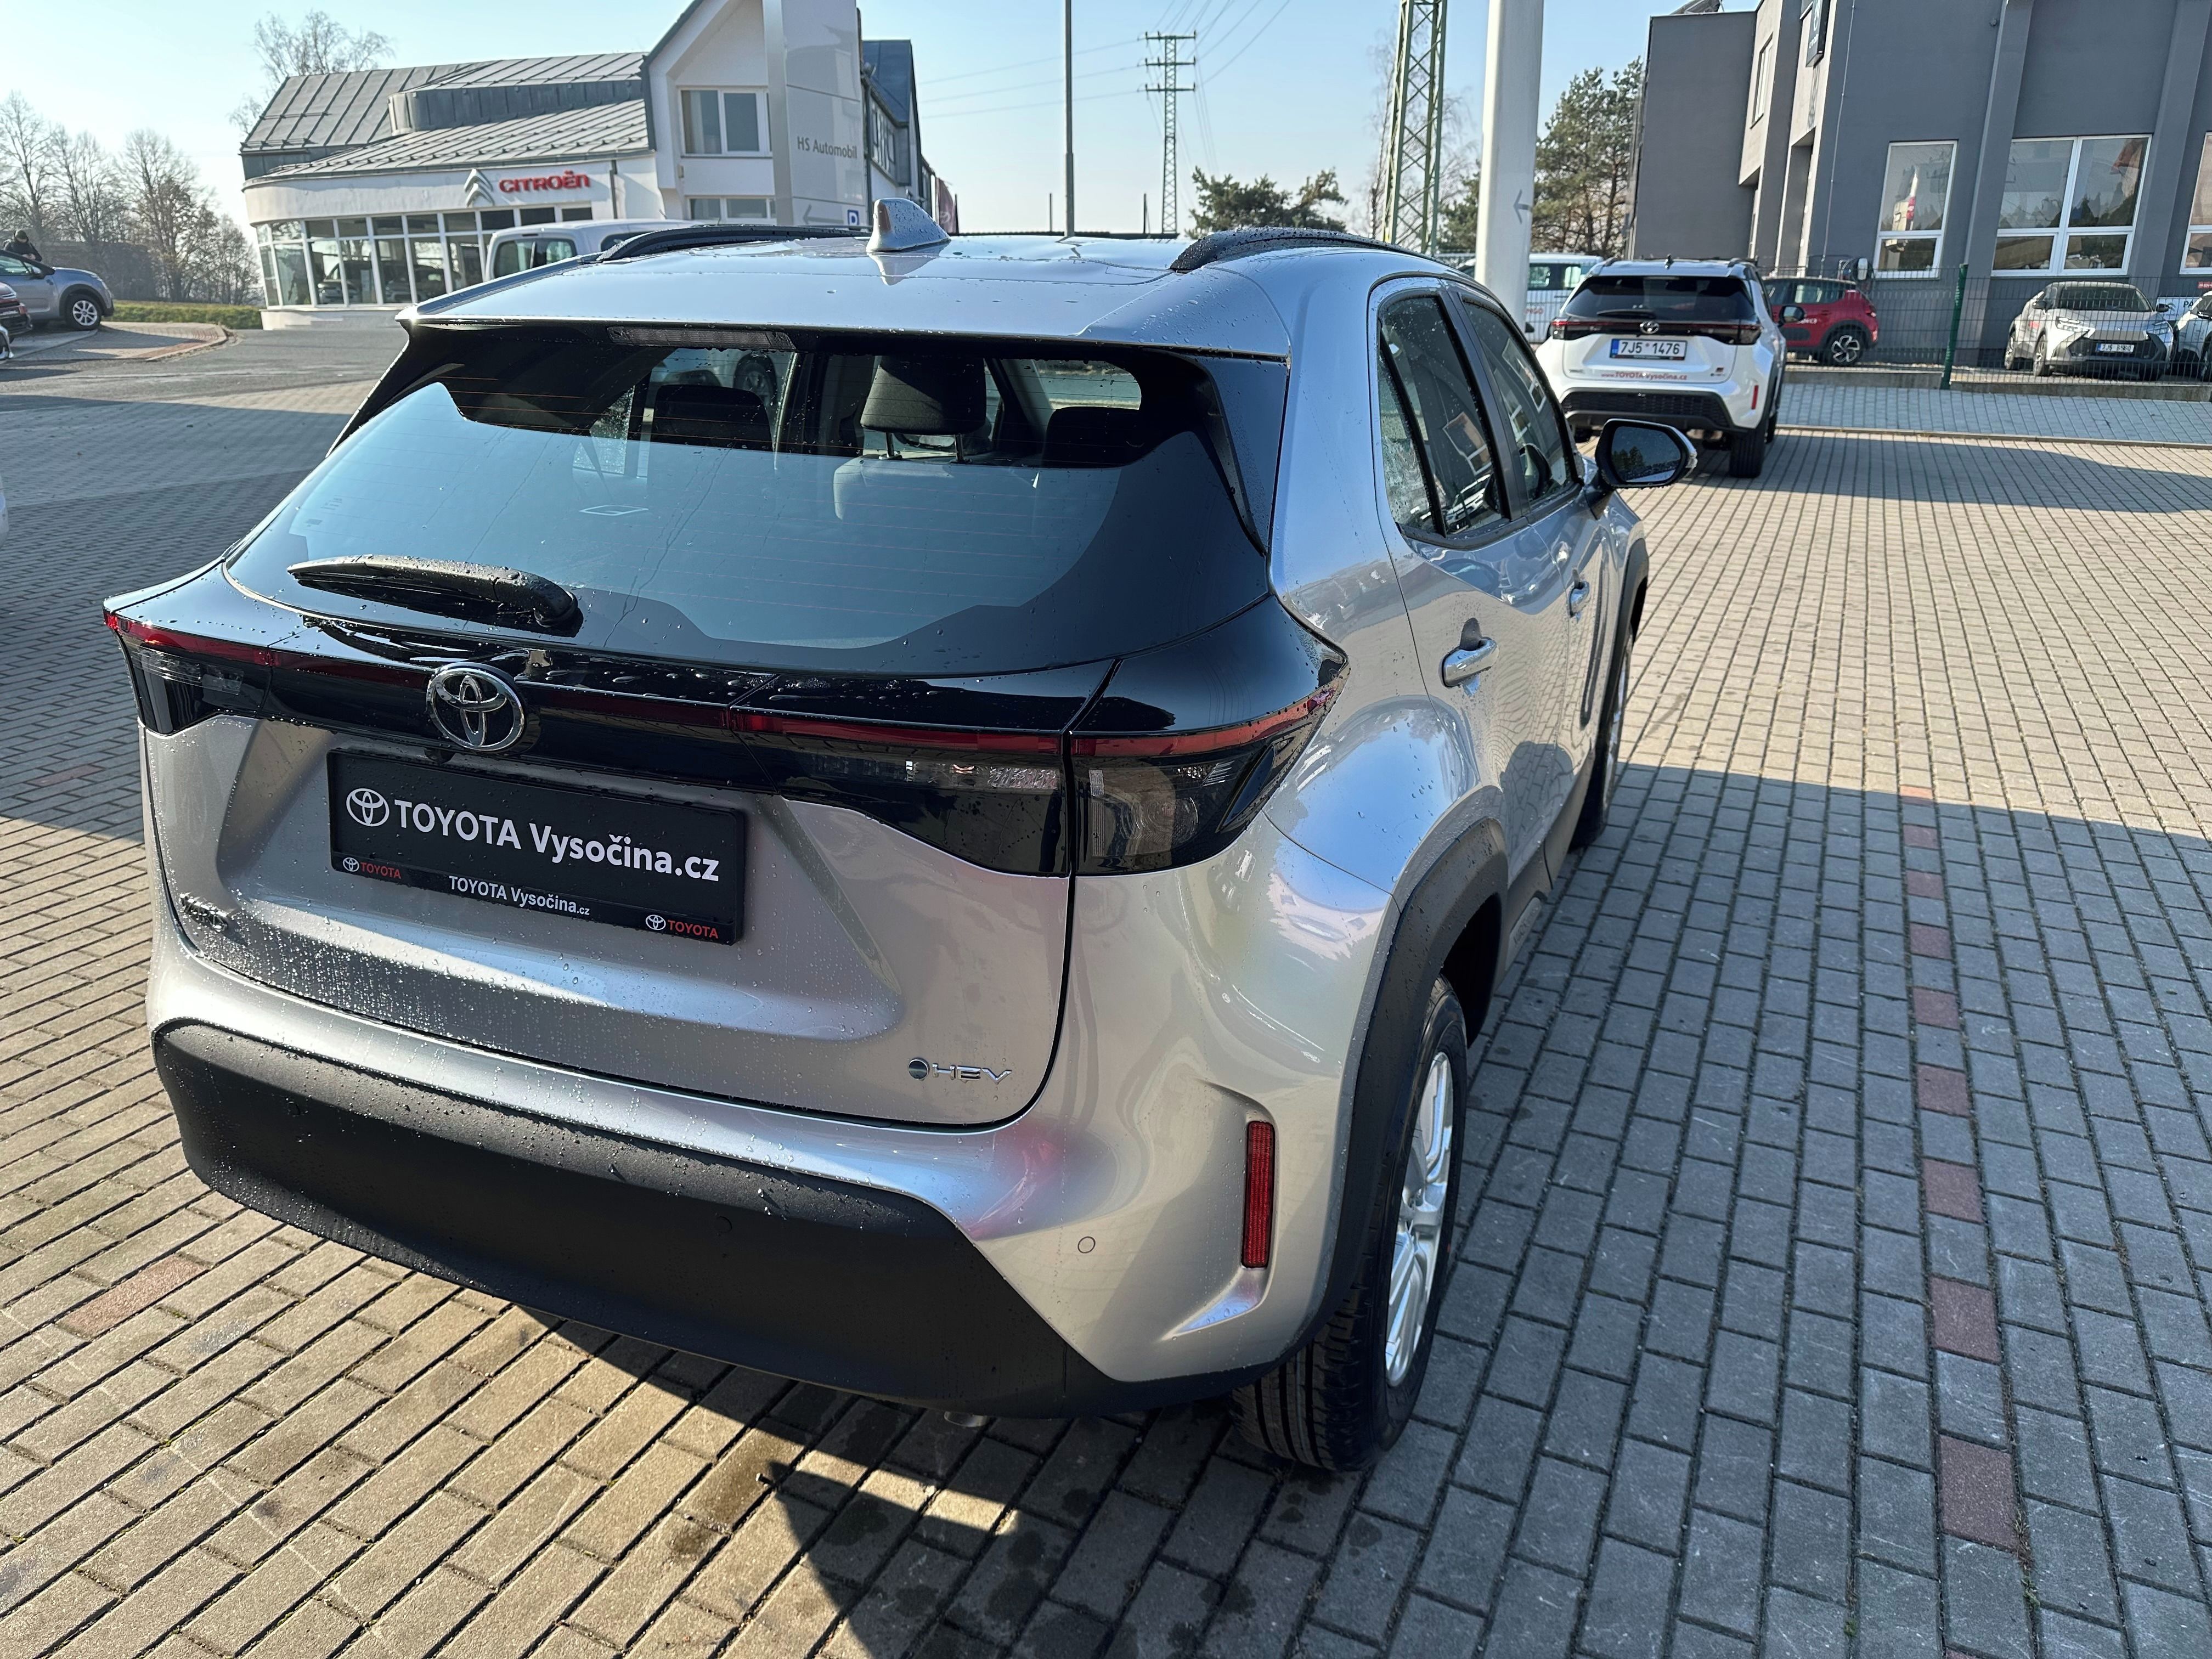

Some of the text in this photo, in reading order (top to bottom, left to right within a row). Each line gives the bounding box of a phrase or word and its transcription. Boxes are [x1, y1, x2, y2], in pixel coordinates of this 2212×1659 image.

[797, 136, 810, 151] HS
[1621, 341, 1679, 355] 7J5 1476
[395, 799, 720, 882] TOYOTA Vysočina.cz
[360, 861, 402, 879] TOYOTA
[449, 875, 590, 916] TOYOTA Vysočina.cz
[667, 919, 719, 939] TOYOTA
[933, 1063, 1013, 1084] HEV
